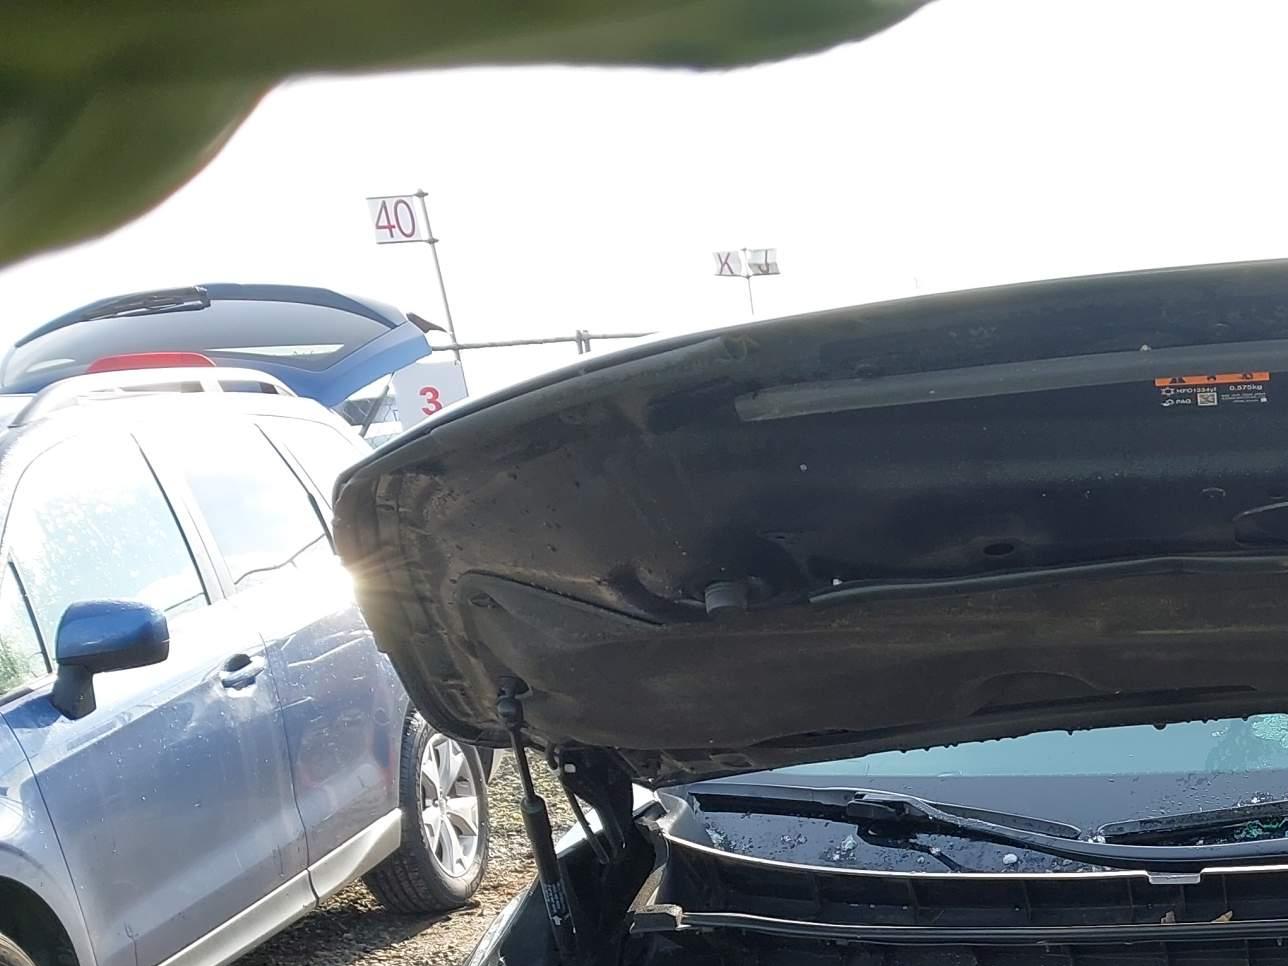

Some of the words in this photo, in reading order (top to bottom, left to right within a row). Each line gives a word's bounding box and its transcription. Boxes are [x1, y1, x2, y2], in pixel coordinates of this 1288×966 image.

[375, 198, 416, 239] 40
[717, 250, 735, 274] K
[758, 248, 770, 274] J
[419, 386, 443, 416] 3
